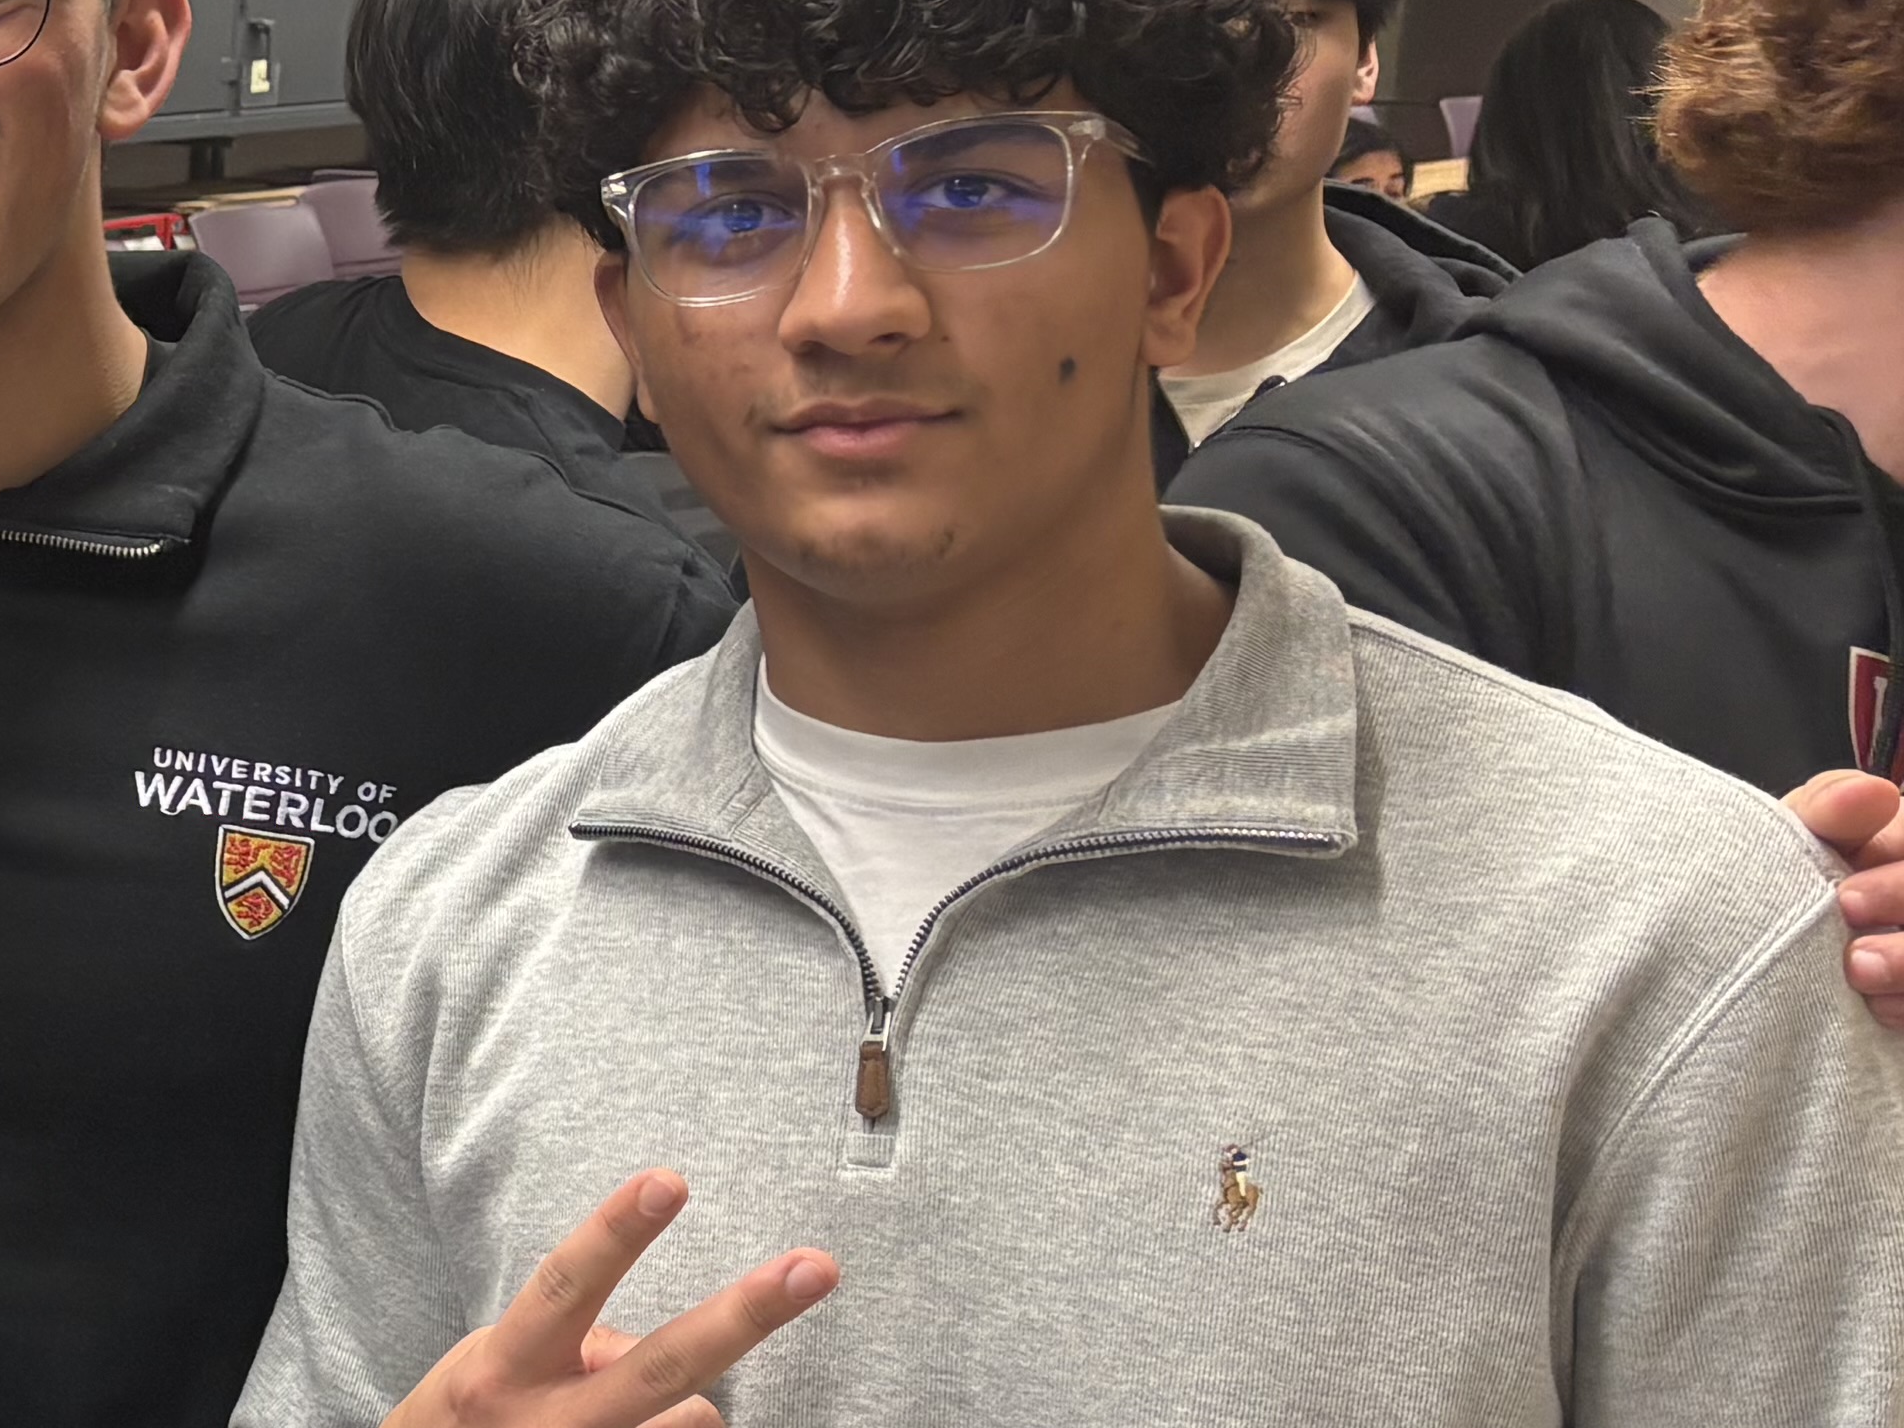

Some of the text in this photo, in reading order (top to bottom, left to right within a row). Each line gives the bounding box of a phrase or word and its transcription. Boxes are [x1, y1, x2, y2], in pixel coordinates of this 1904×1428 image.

[134, 771, 398, 844] WATERLOO
[153, 747, 398, 805] UNIVERSITY OF
